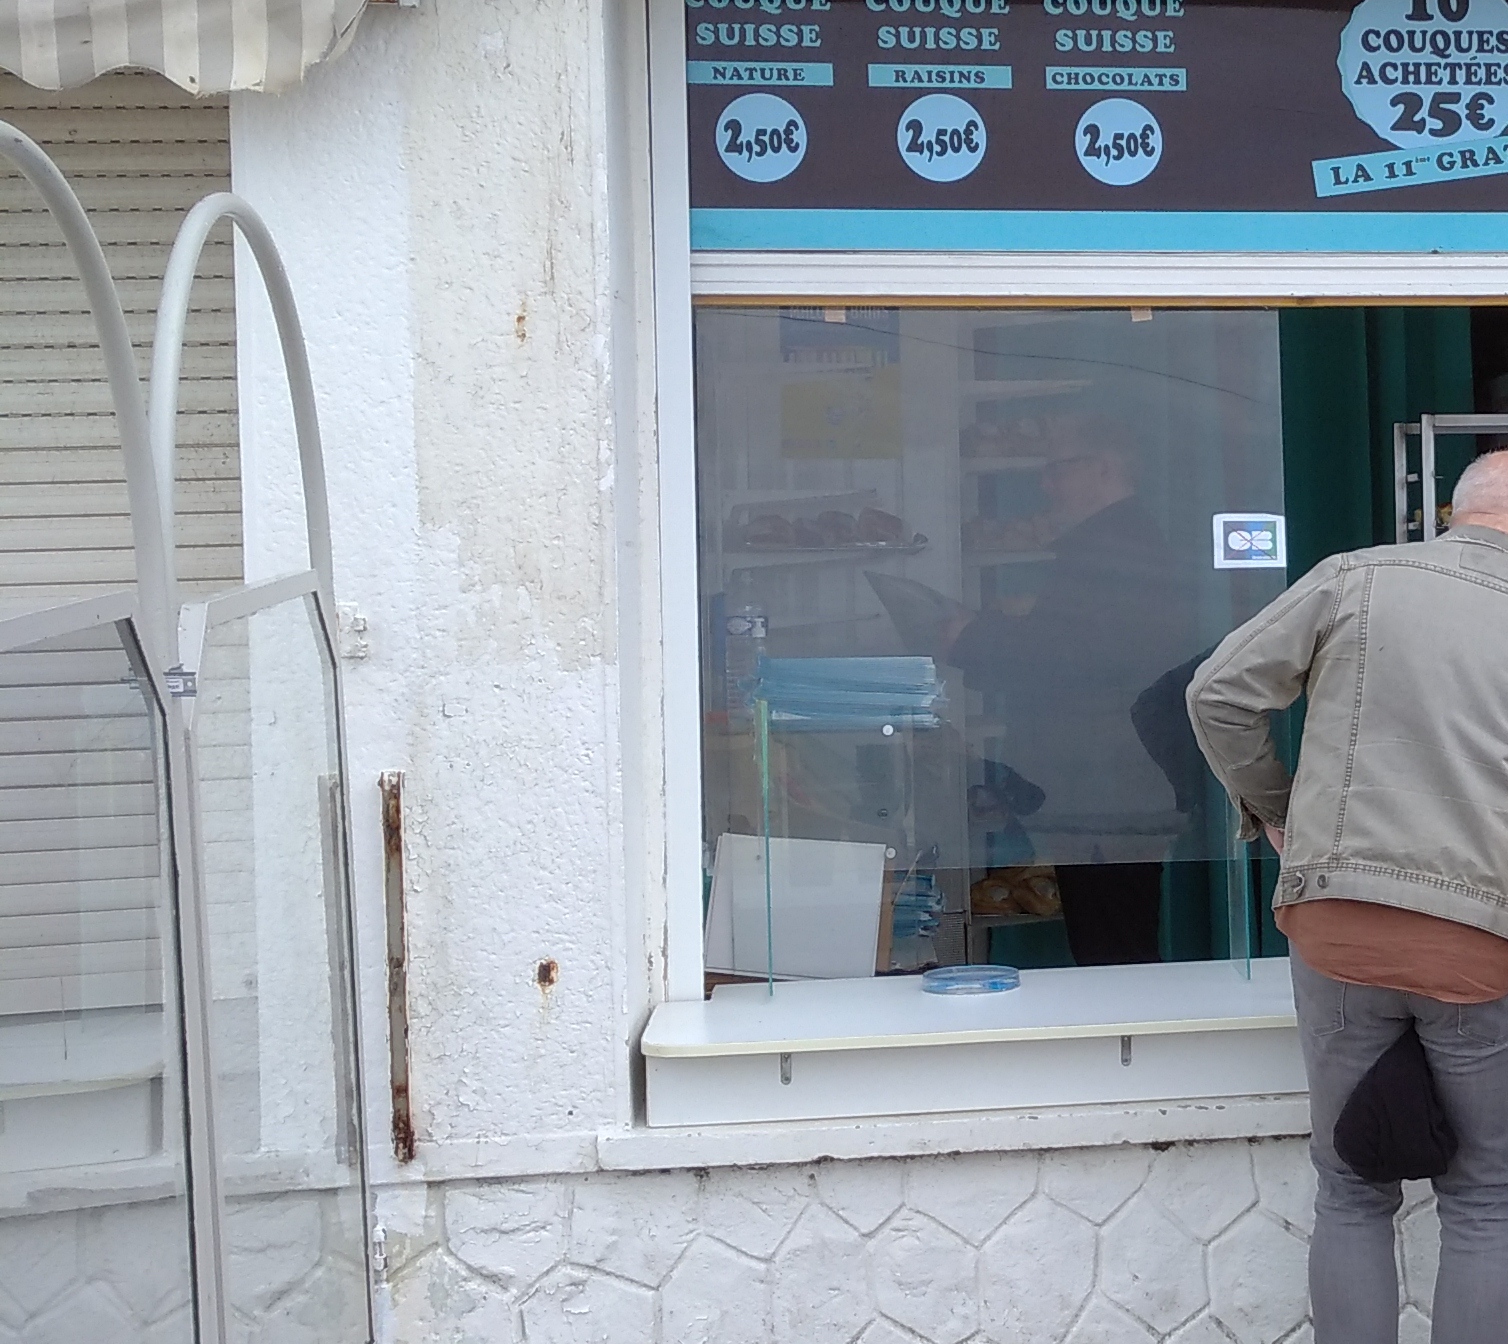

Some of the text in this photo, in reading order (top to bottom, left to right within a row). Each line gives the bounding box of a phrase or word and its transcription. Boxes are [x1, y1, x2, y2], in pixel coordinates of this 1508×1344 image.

[696, 22, 822, 48] SUISSE
[877, 26, 1001, 51] SUISSE
[1054, 29, 1176, 54] SUISSE
[711, 67, 806, 83] NATURE
[893, 69, 986, 84] RAISINS
[1051, 71, 1181, 87] CHOCOLATS
[1389, 92, 1496, 138] 25€
[722, 118, 801, 163] 2,50€
[904, 118, 981, 163] 2,50€
[1083, 122, 1156, 167] 2,50€
[1331, 163, 1373, 187] LA
